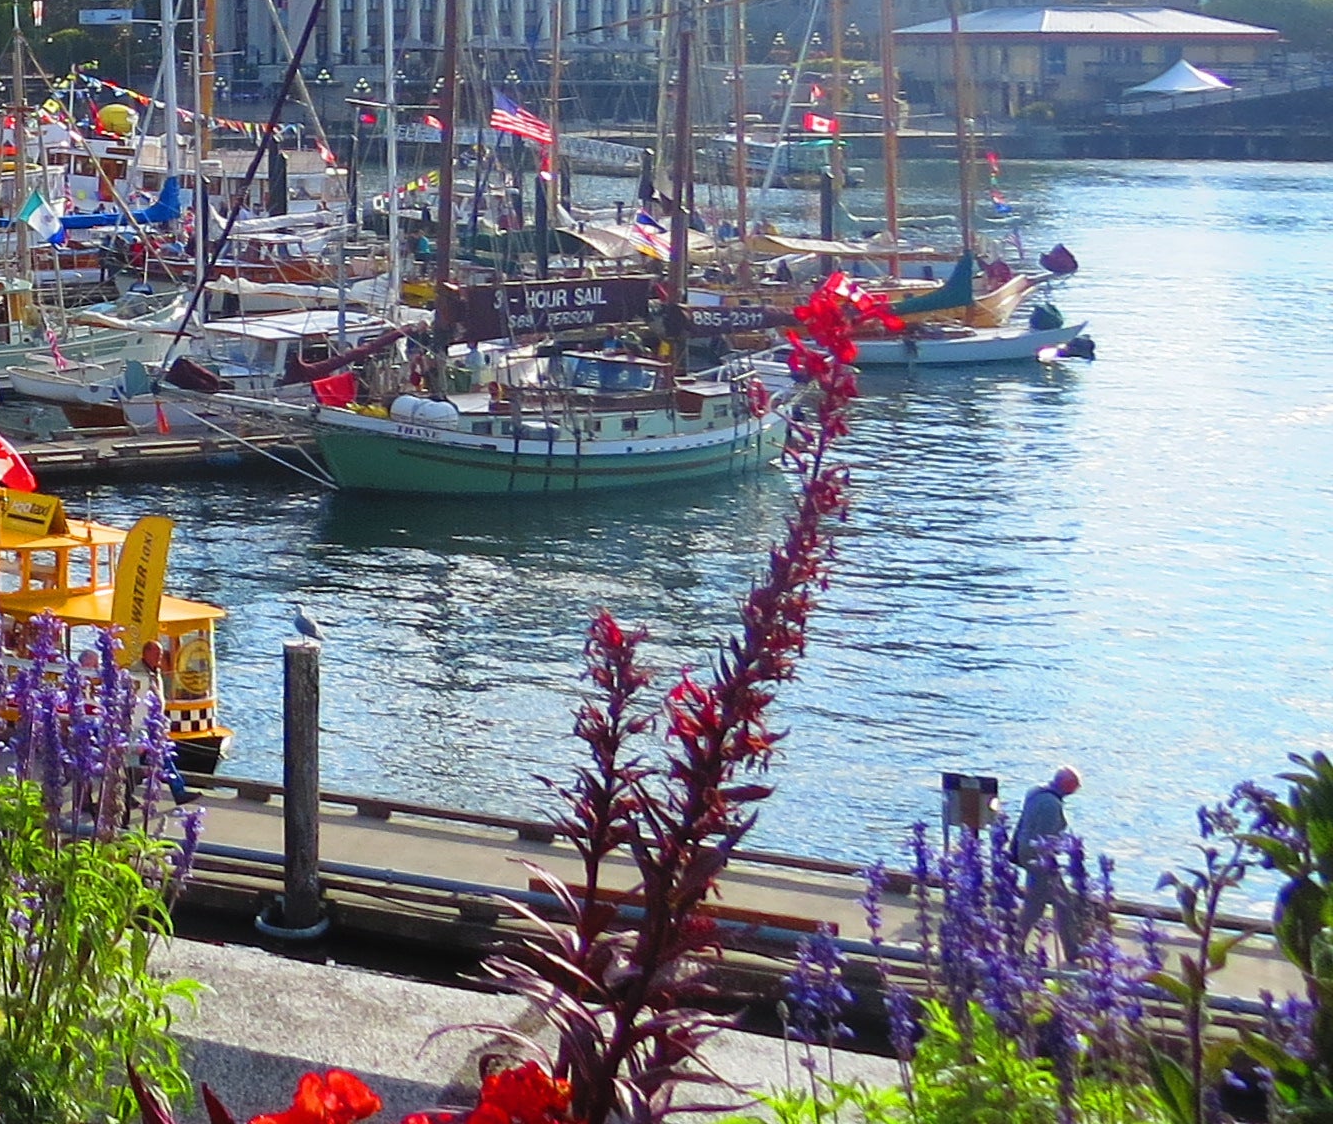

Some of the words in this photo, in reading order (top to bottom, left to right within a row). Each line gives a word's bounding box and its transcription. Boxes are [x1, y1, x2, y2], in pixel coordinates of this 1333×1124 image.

[525, 288, 568, 309] HOUR
[573, 287, 607, 307] SAIL
[547, 310, 594, 327] PERSON
[692, 310, 764, 327] 885-2311
[131, 564, 148, 623] WATER
[141, 529, 154, 564] taxi
